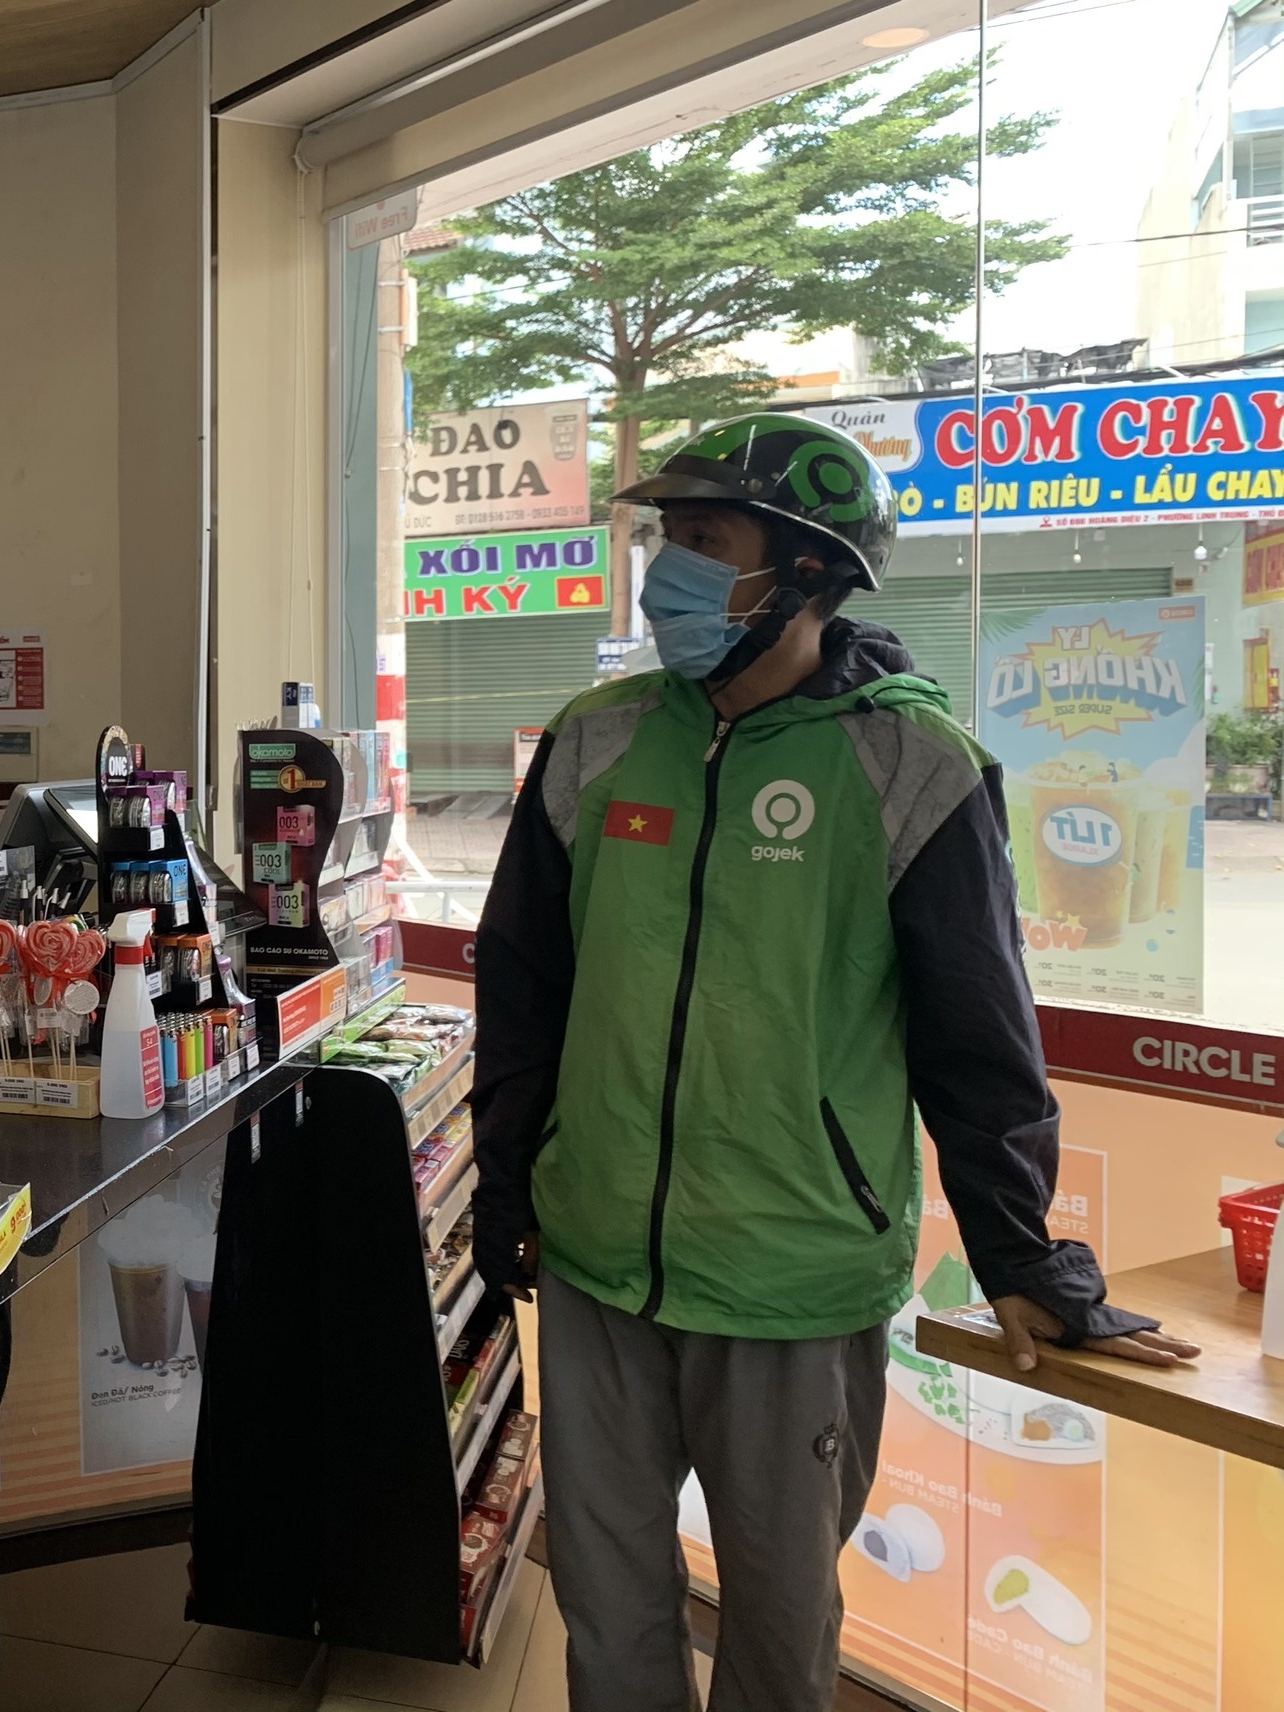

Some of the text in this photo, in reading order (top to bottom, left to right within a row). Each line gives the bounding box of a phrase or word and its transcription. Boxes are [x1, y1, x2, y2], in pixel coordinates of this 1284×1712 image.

[936, 391, 1284, 469] CƠM CHAY
[408, 460, 550, 505] CHIA
[955, 463, 1284, 512] BÚN RIÊU LẨU CHAY
[463, 576, 529, 612] KÝ
[108, 757, 127, 776] ONE
[278, 816, 298, 828] 003
[260, 854, 282, 868] 003
[752, 845, 804, 862] gojek
[276, 895, 298, 909] 003
[293, 948, 328, 956] OKAMOTO
[1132, 1036, 1276, 1086] CIRCLE
[128, 1388, 180, 1401] BLACK COFFEE
[132, 1385, 154, 1393] Nóng
